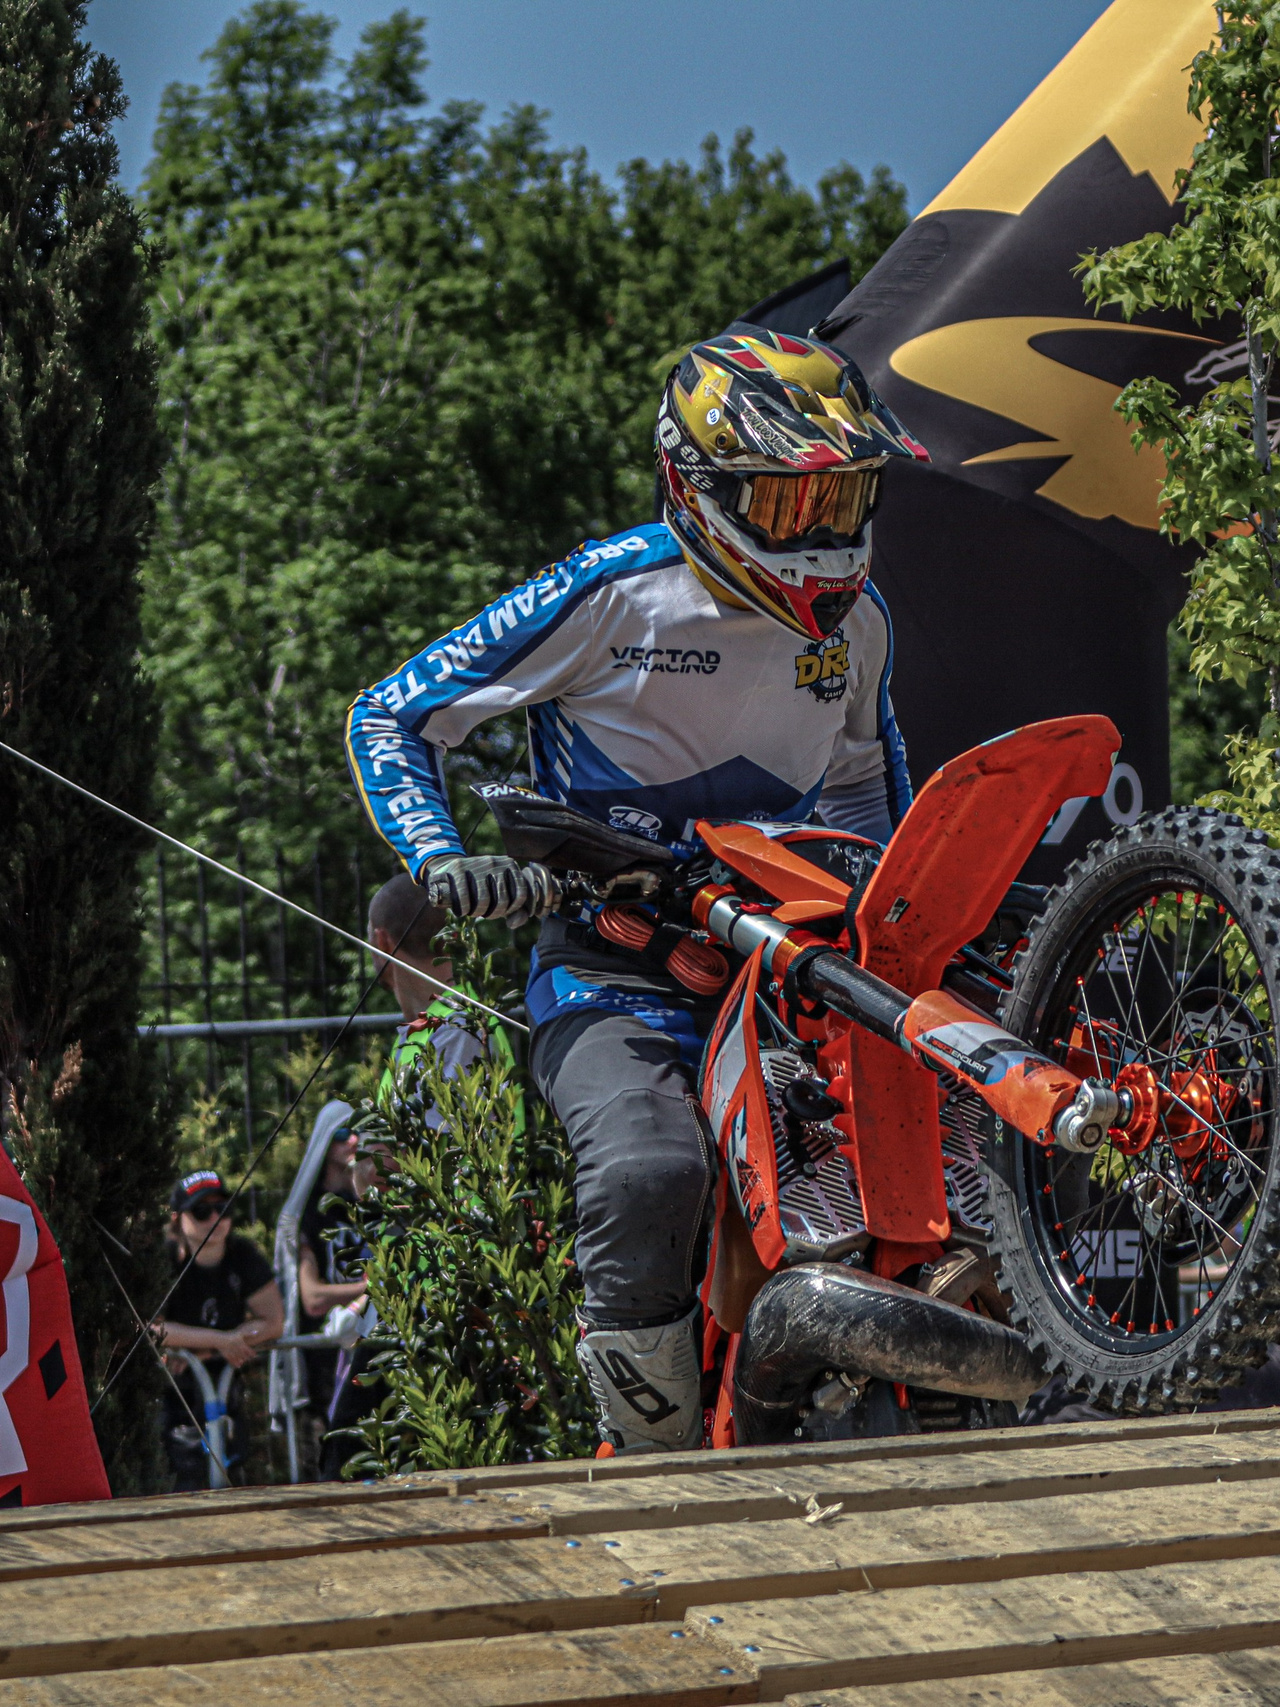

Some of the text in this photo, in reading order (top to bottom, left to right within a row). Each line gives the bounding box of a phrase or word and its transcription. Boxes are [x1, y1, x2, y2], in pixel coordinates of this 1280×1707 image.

[580, 535, 650, 569] DRC
[816, 580, 832, 591] Troy
[832, 580, 844, 588] Lee
[488, 566, 574, 641] TEAM
[426, 623, 488, 683] DRC
[609, 646, 721, 665] VECTOR
[637, 661, 719, 675] RACING
[824, 689, 844, 699] CAMP
[361, 718, 451, 860] DRC TEAM
[951, 1049, 987, 1073] ENDURO
